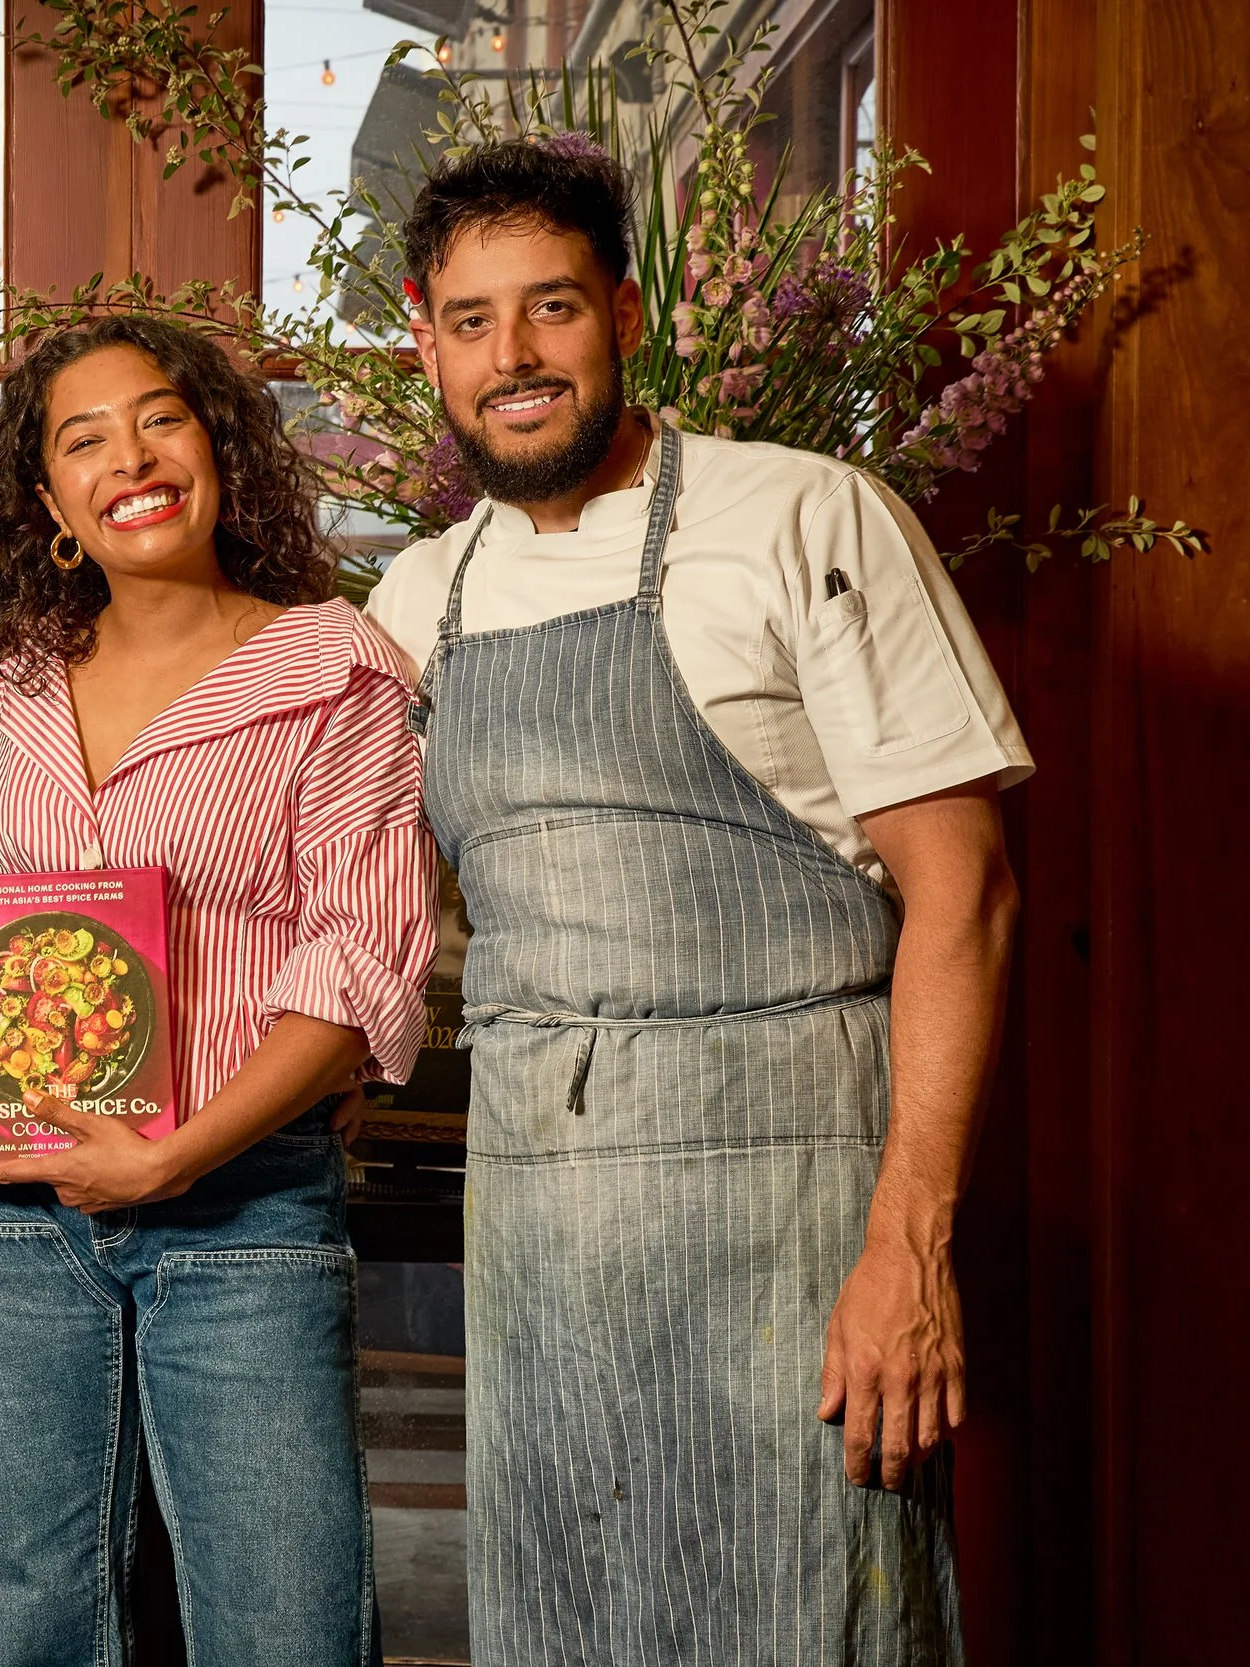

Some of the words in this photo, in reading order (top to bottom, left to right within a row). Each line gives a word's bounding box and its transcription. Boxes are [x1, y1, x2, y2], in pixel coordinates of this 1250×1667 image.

[27, 884, 53, 893] HOME
[55, 882, 96, 891] COOKING
[98, 881, 123, 890] FROM
[12, 896, 40, 905] ASIA'S
[42, 895, 64, 903] BEST
[66, 893, 91, 902] SPICE
[93, 892, 124, 901] FARMS
[45, 1083, 77, 1099] THE
[70, 1098, 127, 1115] SPICE
[130, 1097, 162, 1115] Co.
[18, 1143, 47, 1152] JAVERI
[48, 1142, 73, 1150] KADRI
